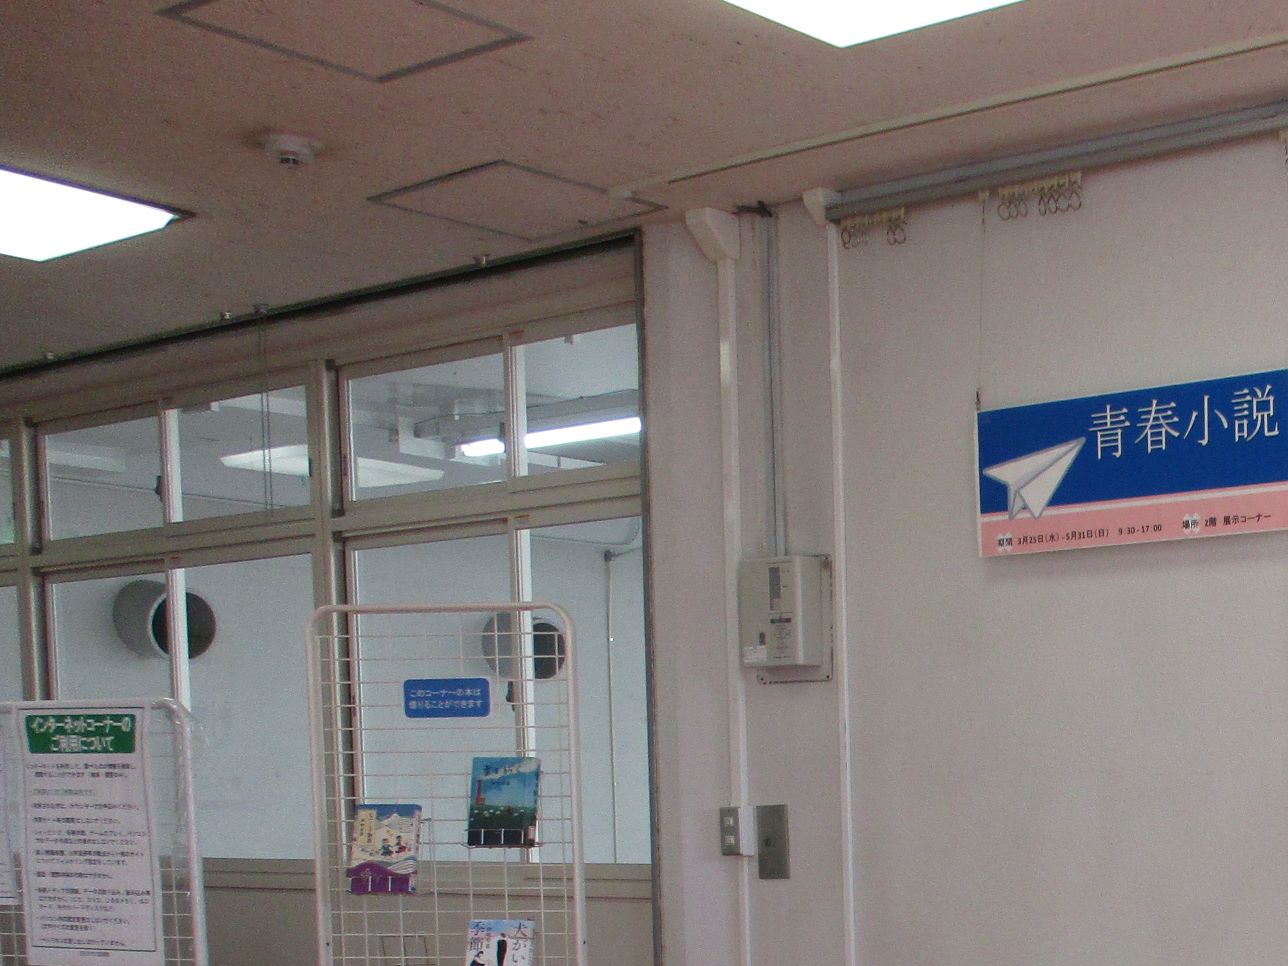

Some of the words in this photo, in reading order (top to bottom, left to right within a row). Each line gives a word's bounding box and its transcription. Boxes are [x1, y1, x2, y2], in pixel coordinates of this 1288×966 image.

[1088, 384, 1279, 460] 青春小説
[1204, 518, 1217, 528] 2階
[1222, 513, 1272, 526] 展示コーナー
[410, 688, 482, 698] このコーナーの本は
[31, 715, 132, 734] インターネットコーナーの
[49, 734, 115, 752] ご利用について
